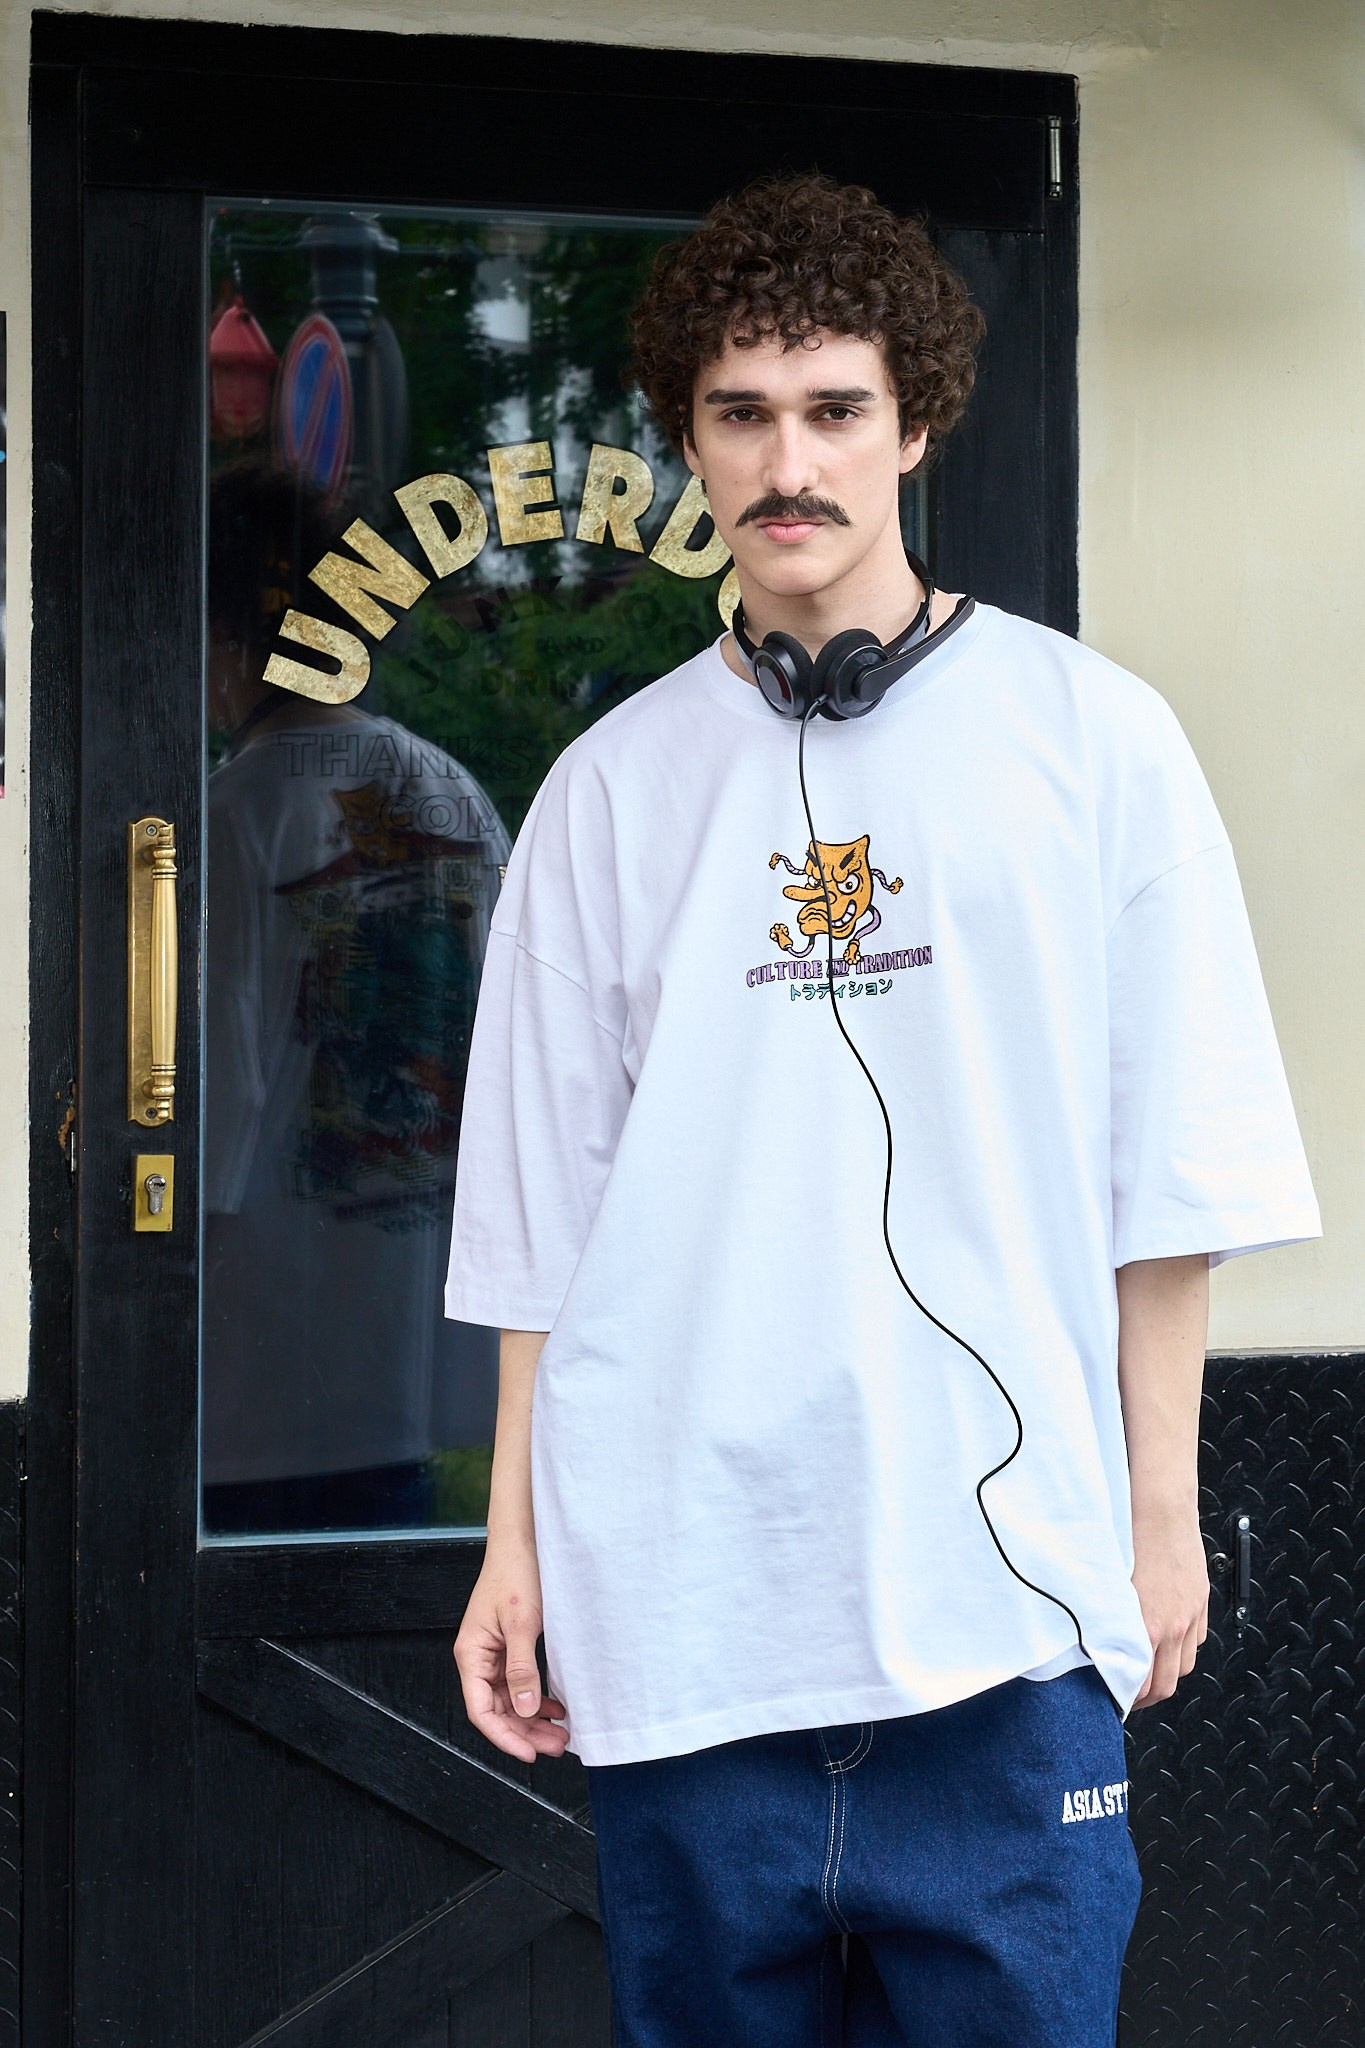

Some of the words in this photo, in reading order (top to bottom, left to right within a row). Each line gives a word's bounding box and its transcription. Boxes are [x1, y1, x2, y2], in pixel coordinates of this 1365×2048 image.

[277, 732, 532, 781] THANKS
[380, 794, 530, 838] COM
[745, 959, 823, 988] CULTURE
[855, 945, 933, 975] TRADITION
[790, 978, 893, 1001] トラディション
